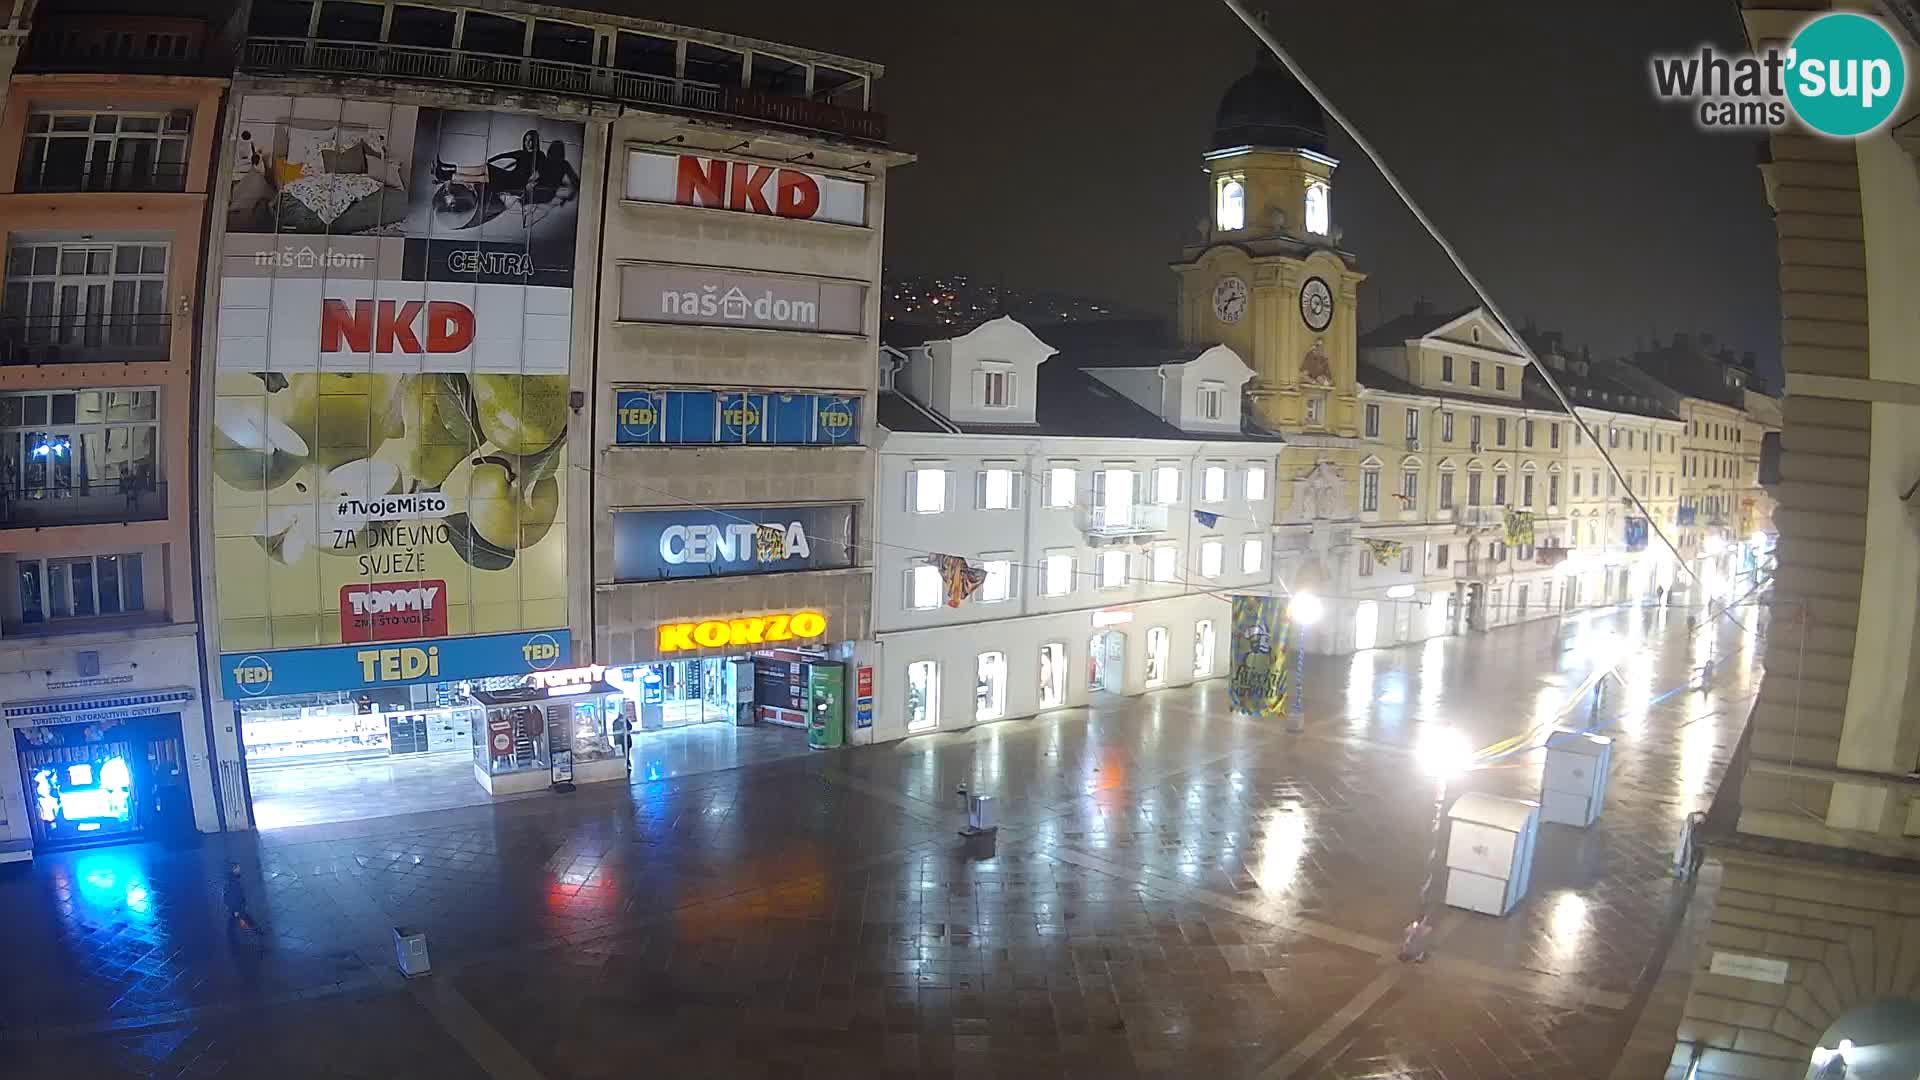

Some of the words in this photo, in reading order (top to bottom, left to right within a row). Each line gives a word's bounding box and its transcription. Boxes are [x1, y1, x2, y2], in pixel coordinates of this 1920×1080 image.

[675, 154, 820, 220] NKD
[255, 247, 293, 268] naš
[319, 249, 365, 269] dom
[448, 250, 535, 276] CENTRA
[661, 283, 718, 318] naš
[753, 290, 816, 324] dom
[320, 297, 477, 354] NKD
[618, 408, 658, 426] TEDi
[723, 409, 760, 426] TEDi
[819, 411, 853, 428] TEDi
[338, 498, 446, 517] #TvojeMisto
[333, 529, 357, 549] ZA
[366, 524, 450, 548] DNEVNO
[659, 521, 811, 565] CENTA
[359, 548, 426, 576] SVJEŽE
[348, 586, 439, 615] TOMMY
[658, 611, 827, 653] KORZO
[357, 646, 439, 683] TEDi
[523, 643, 560, 661] TEDi
[233, 666, 273, 684] TEDi
